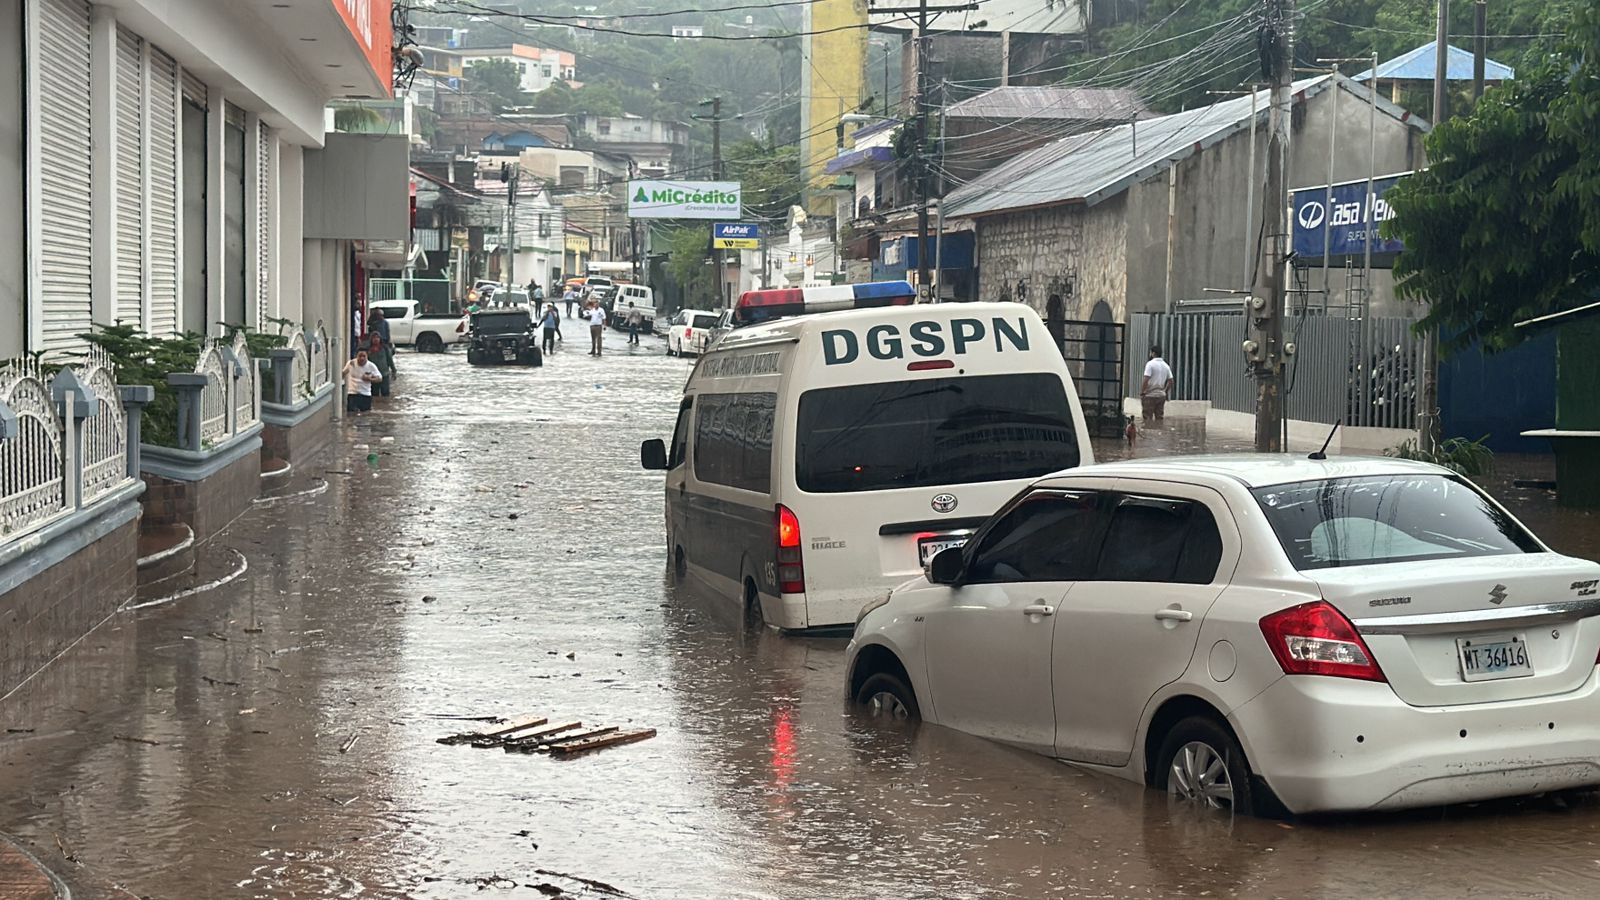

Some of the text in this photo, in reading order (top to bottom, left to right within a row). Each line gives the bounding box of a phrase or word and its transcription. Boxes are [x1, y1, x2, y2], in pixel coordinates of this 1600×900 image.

[652, 188, 737, 204] MiCrédito
[722, 225, 749, 234] AirPak
[821, 317, 1030, 366] DGSPN
[811, 541, 846, 550] HIACE
[1464, 646, 1525, 670] MT 36416
